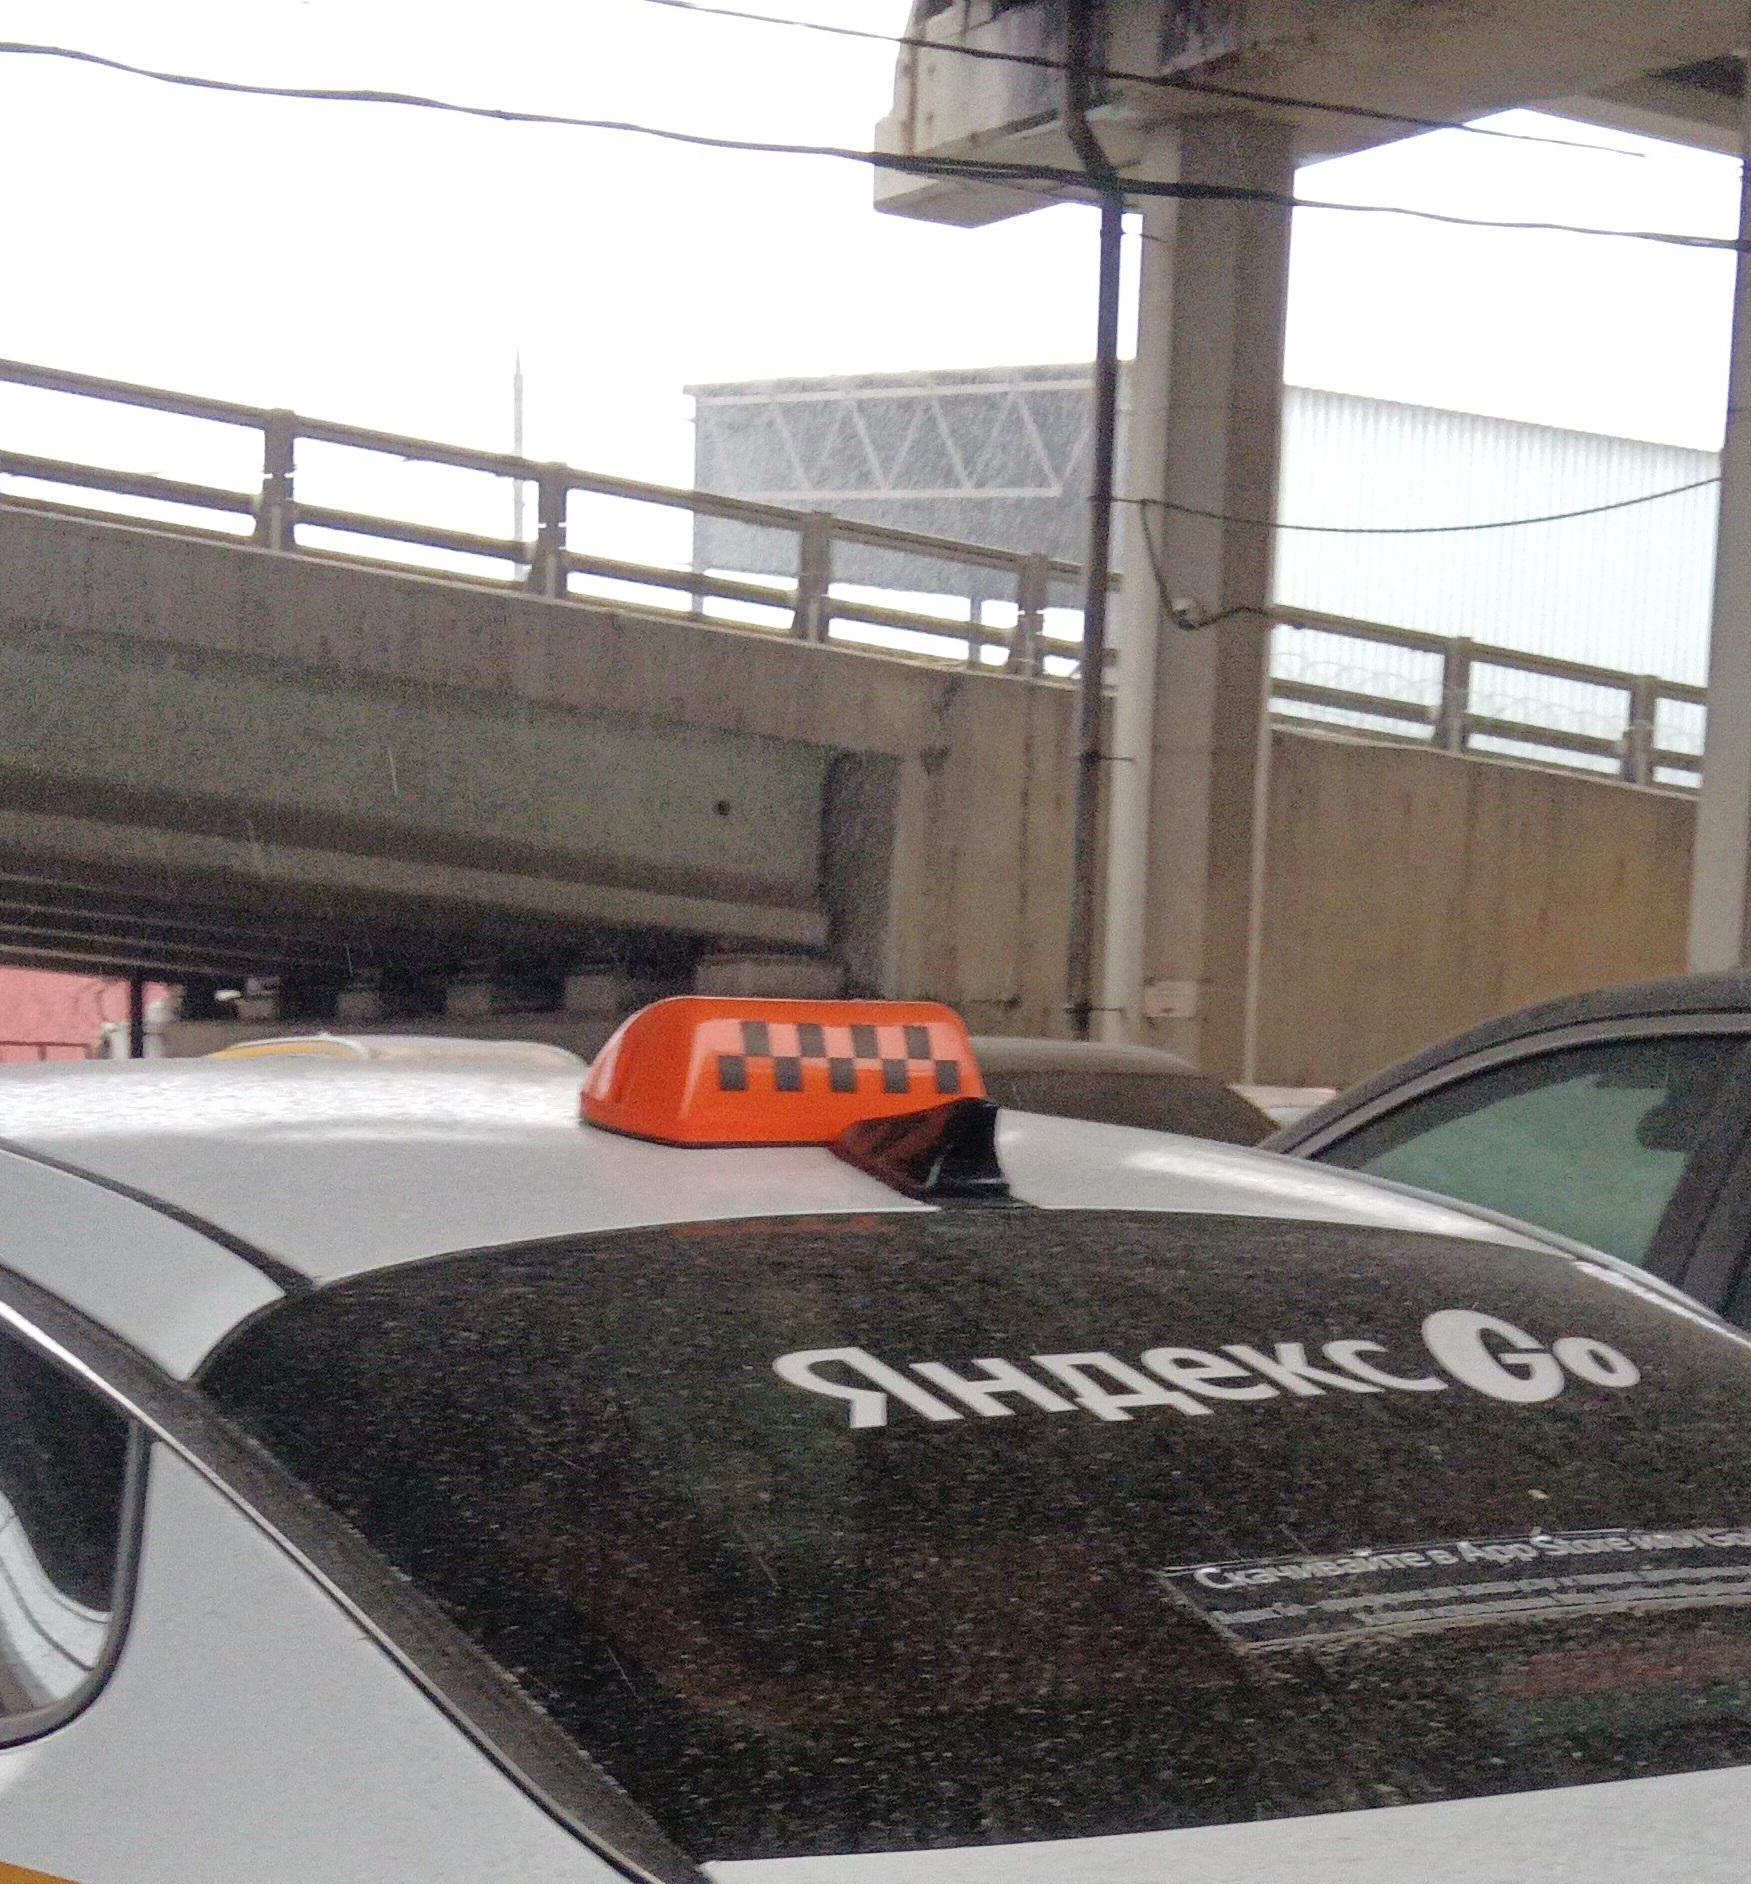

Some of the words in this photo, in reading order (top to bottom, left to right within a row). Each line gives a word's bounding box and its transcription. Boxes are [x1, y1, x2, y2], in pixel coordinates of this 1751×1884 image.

[771, 1338, 1446, 1430] Яндекс
[1420, 1307, 1643, 1404] Go
[1193, 1548, 1430, 1589] Скачивайте
[1455, 1541, 1538, 1565] App
[1529, 1534, 1636, 1556] Store
